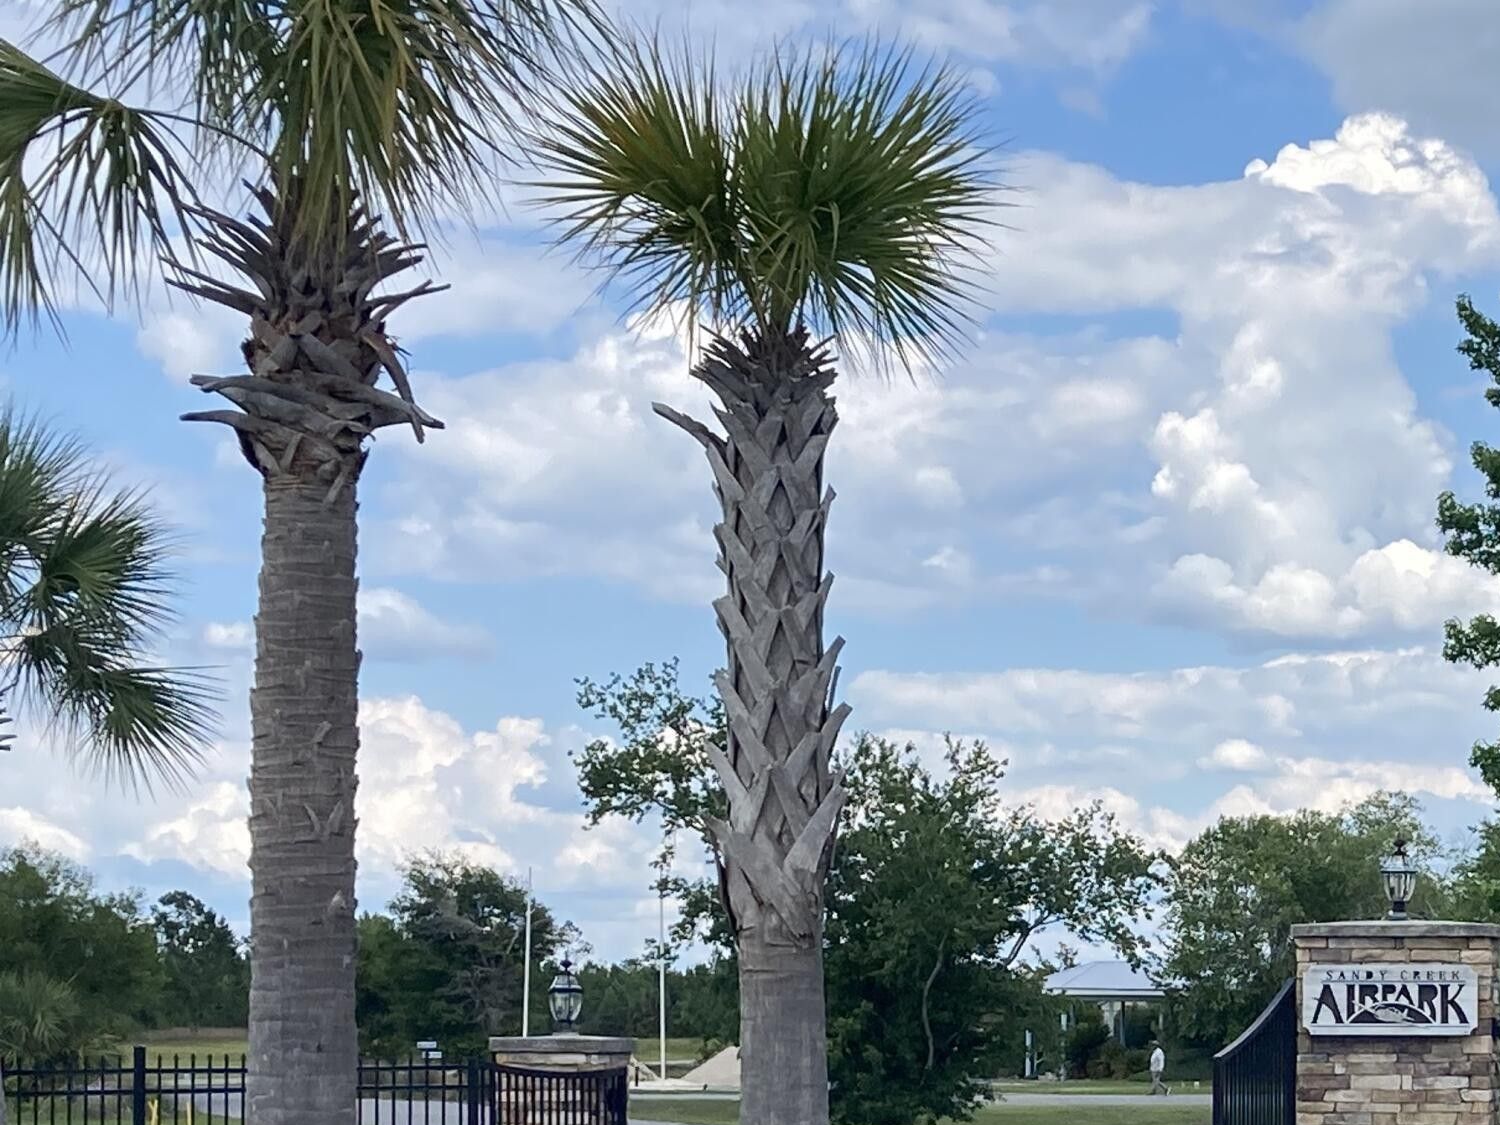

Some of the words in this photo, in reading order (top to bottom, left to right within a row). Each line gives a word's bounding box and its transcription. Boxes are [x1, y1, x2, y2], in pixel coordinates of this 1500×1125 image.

[1325, 970, 1388, 981] SANDY
[1400, 970, 1461, 981] CREEK
[1311, 983, 1470, 1024] AIRPARK
